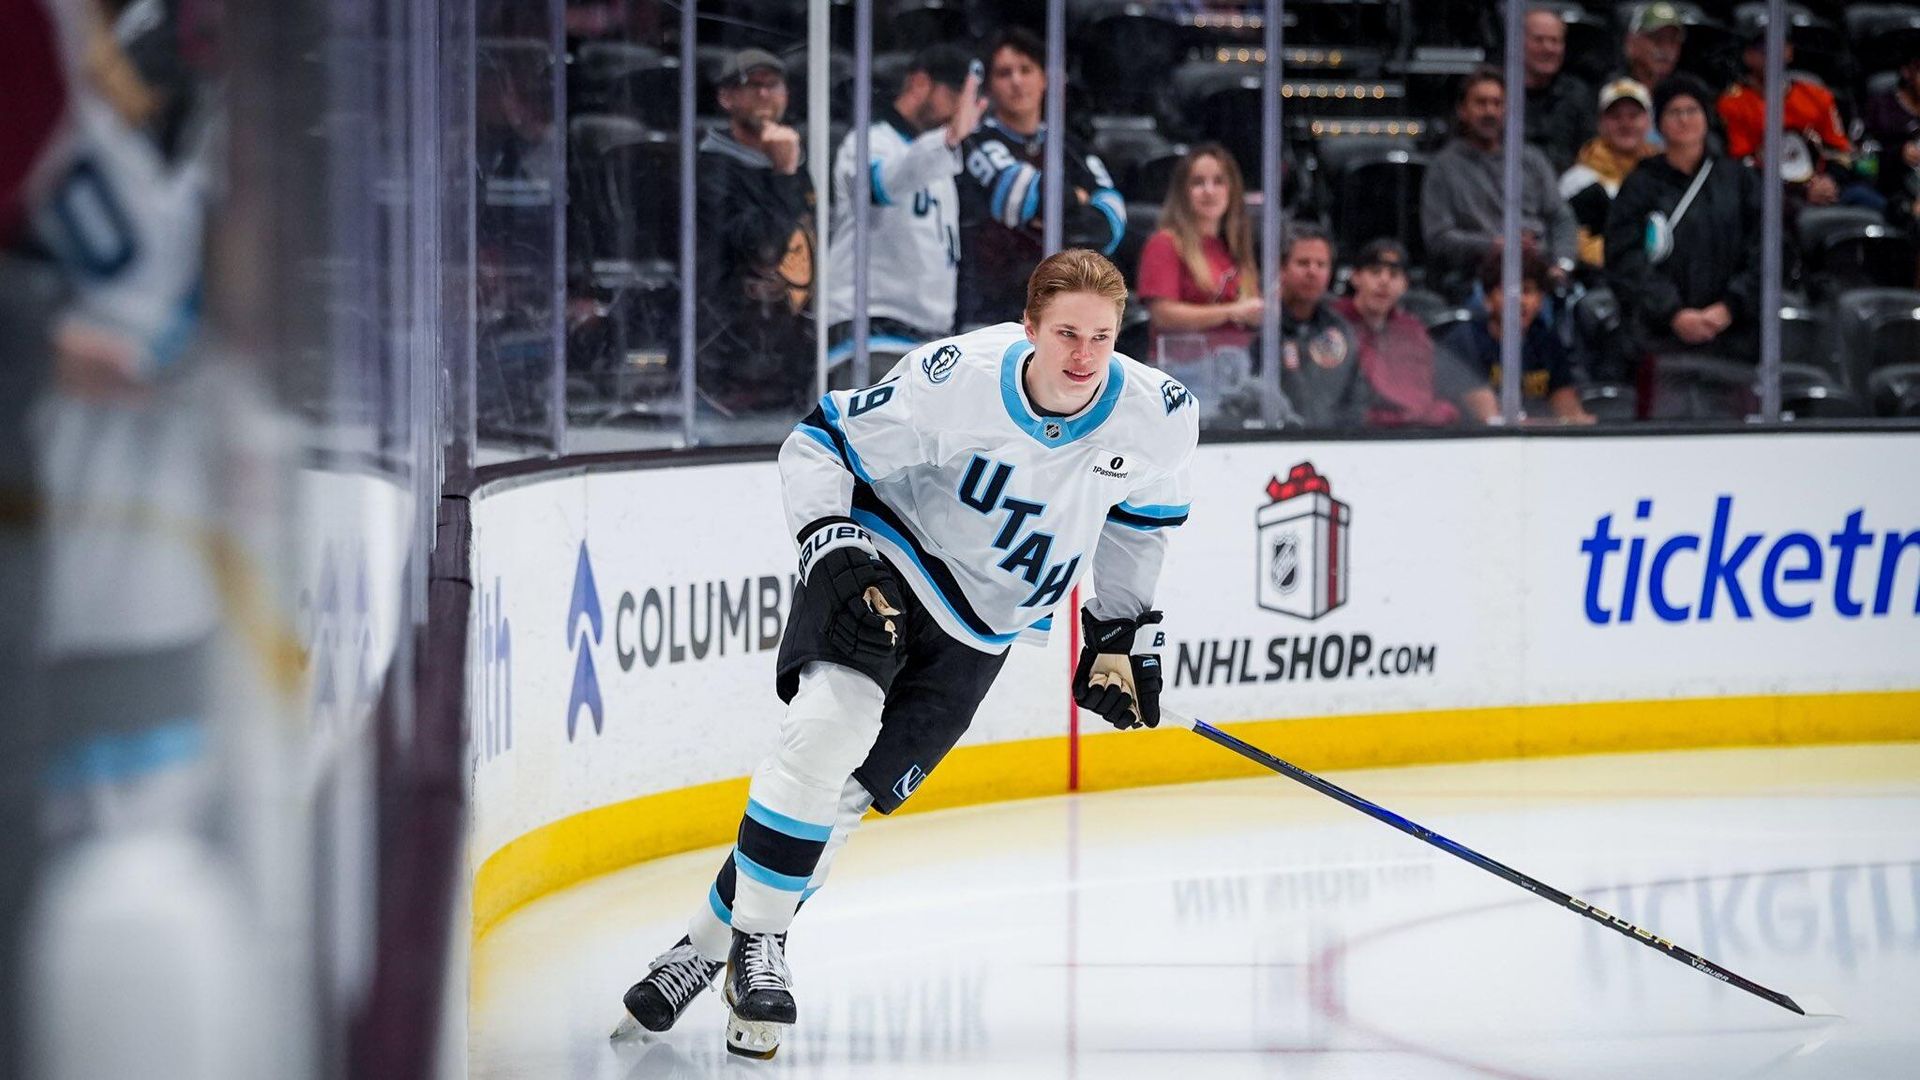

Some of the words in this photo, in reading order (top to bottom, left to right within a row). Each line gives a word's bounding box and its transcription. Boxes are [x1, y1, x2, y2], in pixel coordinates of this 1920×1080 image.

[967, 139, 1016, 187] 92
[847, 375, 902, 417] 9
[1092, 465, 1129, 479] 1Password
[957, 453, 1082, 608] UTAH
[616, 573, 797, 672] COLUMB
